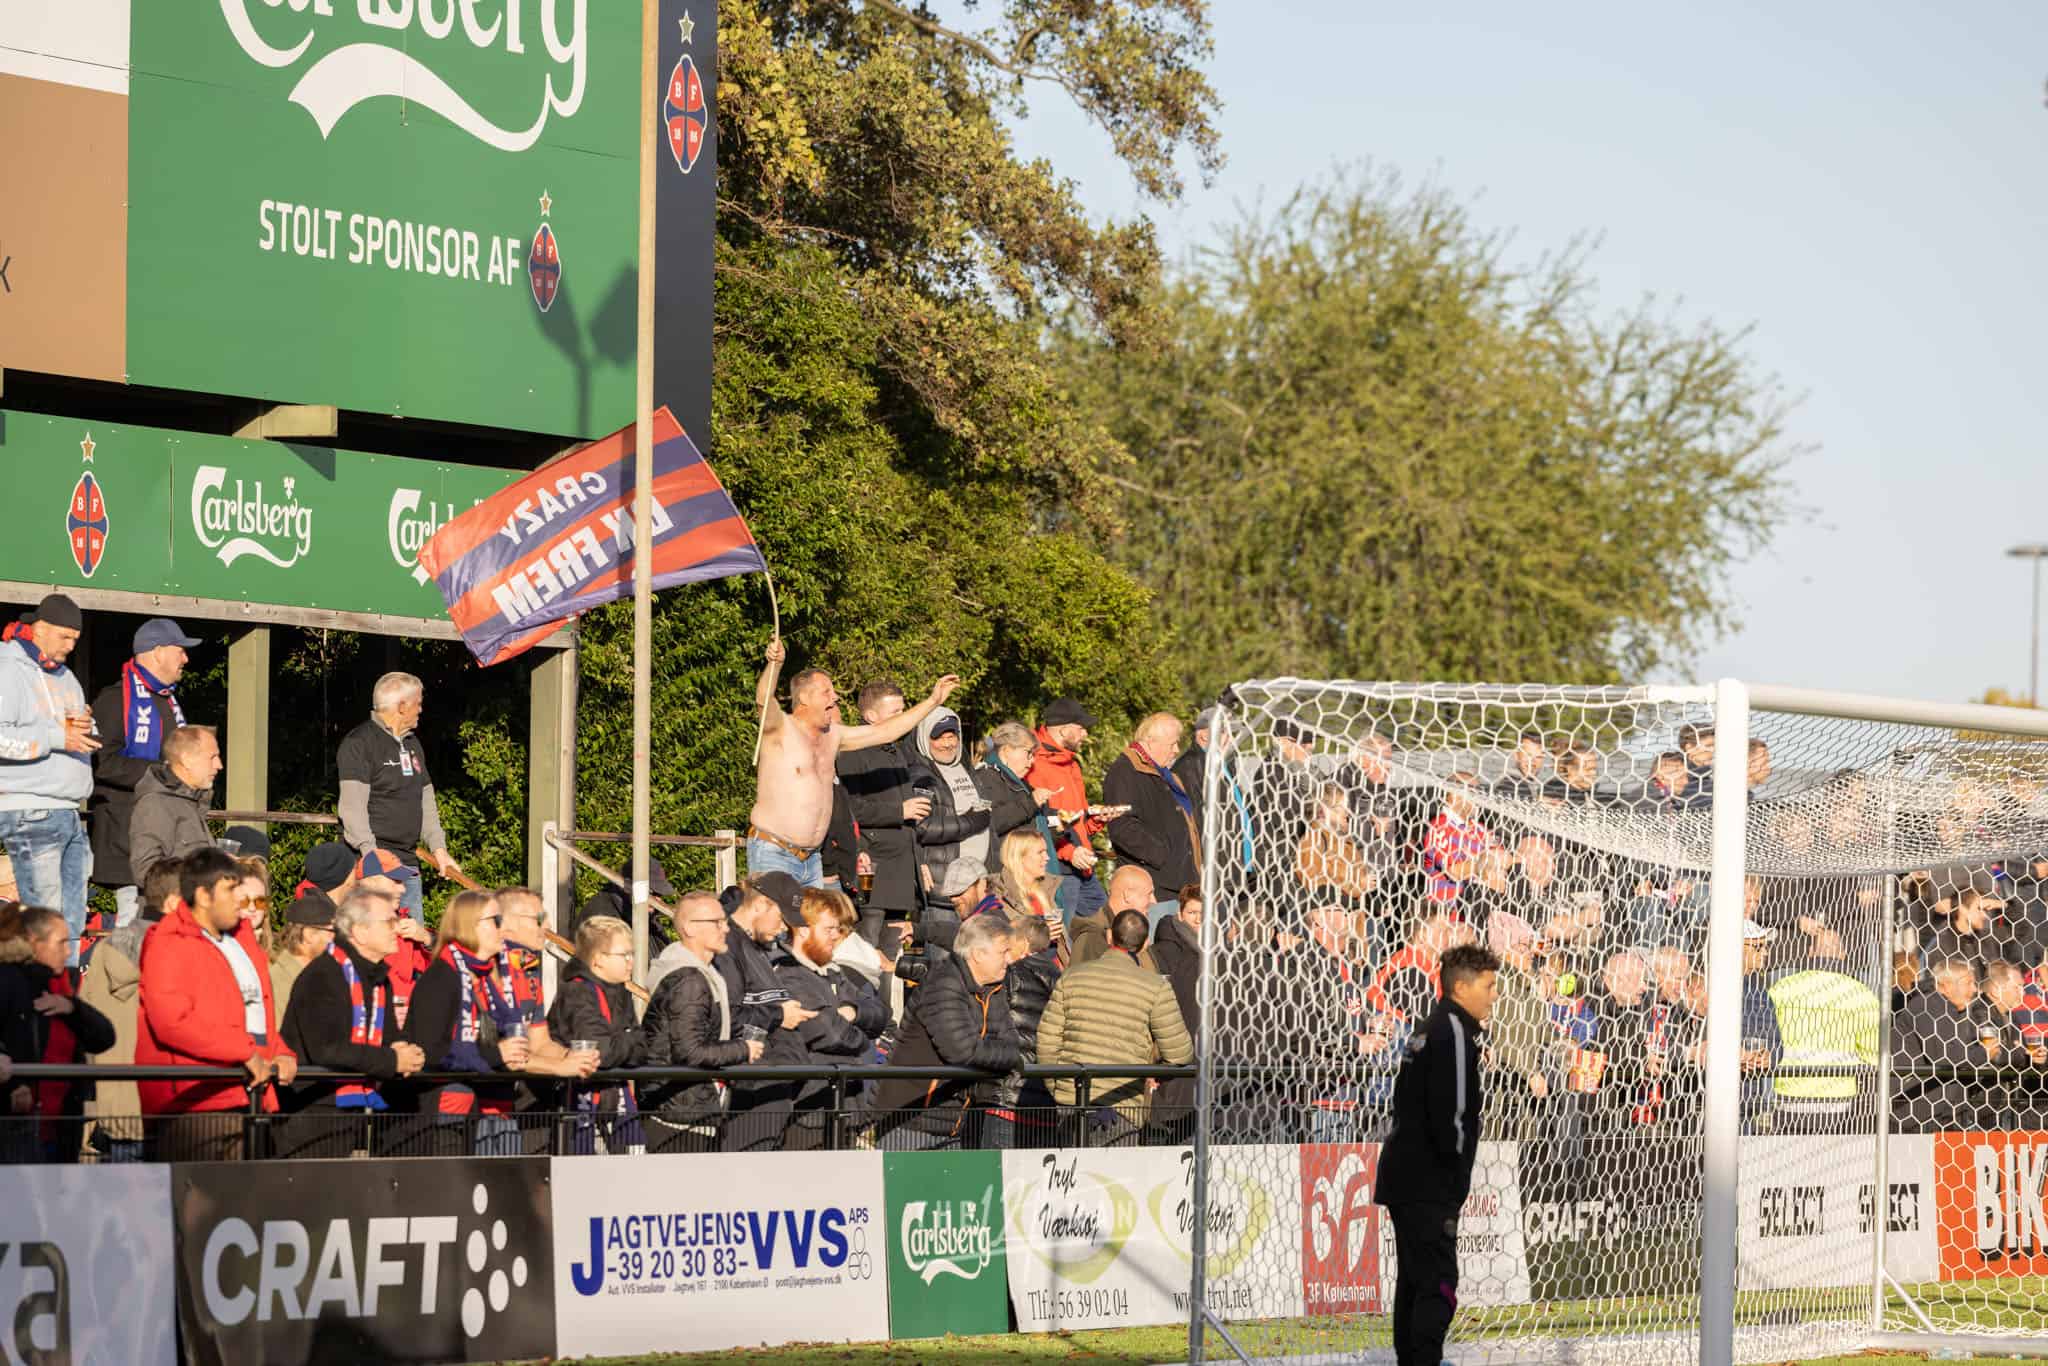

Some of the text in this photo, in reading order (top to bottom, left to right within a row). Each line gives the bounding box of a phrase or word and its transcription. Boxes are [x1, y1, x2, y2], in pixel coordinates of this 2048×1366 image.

[674, 81, 698, 101] B F
[259, 199, 520, 286] STOLT SPONSOR AF
[77, 496, 99, 513] B F
[191, 465, 312, 557] Carlsberg
[134, 705, 152, 743] BK
[1042, 1153, 1077, 1195] Tryl
[747, 1207, 849, 1270] VVS
[849, 1208, 869, 1225] APS
[901, 1201, 991, 1272] Carlsberg
[1039, 1202, 1099, 1247] Værktøj
[1524, 1201, 1605, 1245] CRAFT
[203, 1216, 458, 1326] CRAFT
[650, 1250, 675, 1279] 20
[682, 1249, 705, 1277] 30
[1058, 1291, 1074, 1319] 56
[1077, 1290, 1092, 1317] 39
[1094, 1288, 1110, 1316] 02
[1113, 1288, 1128, 1315] 04
